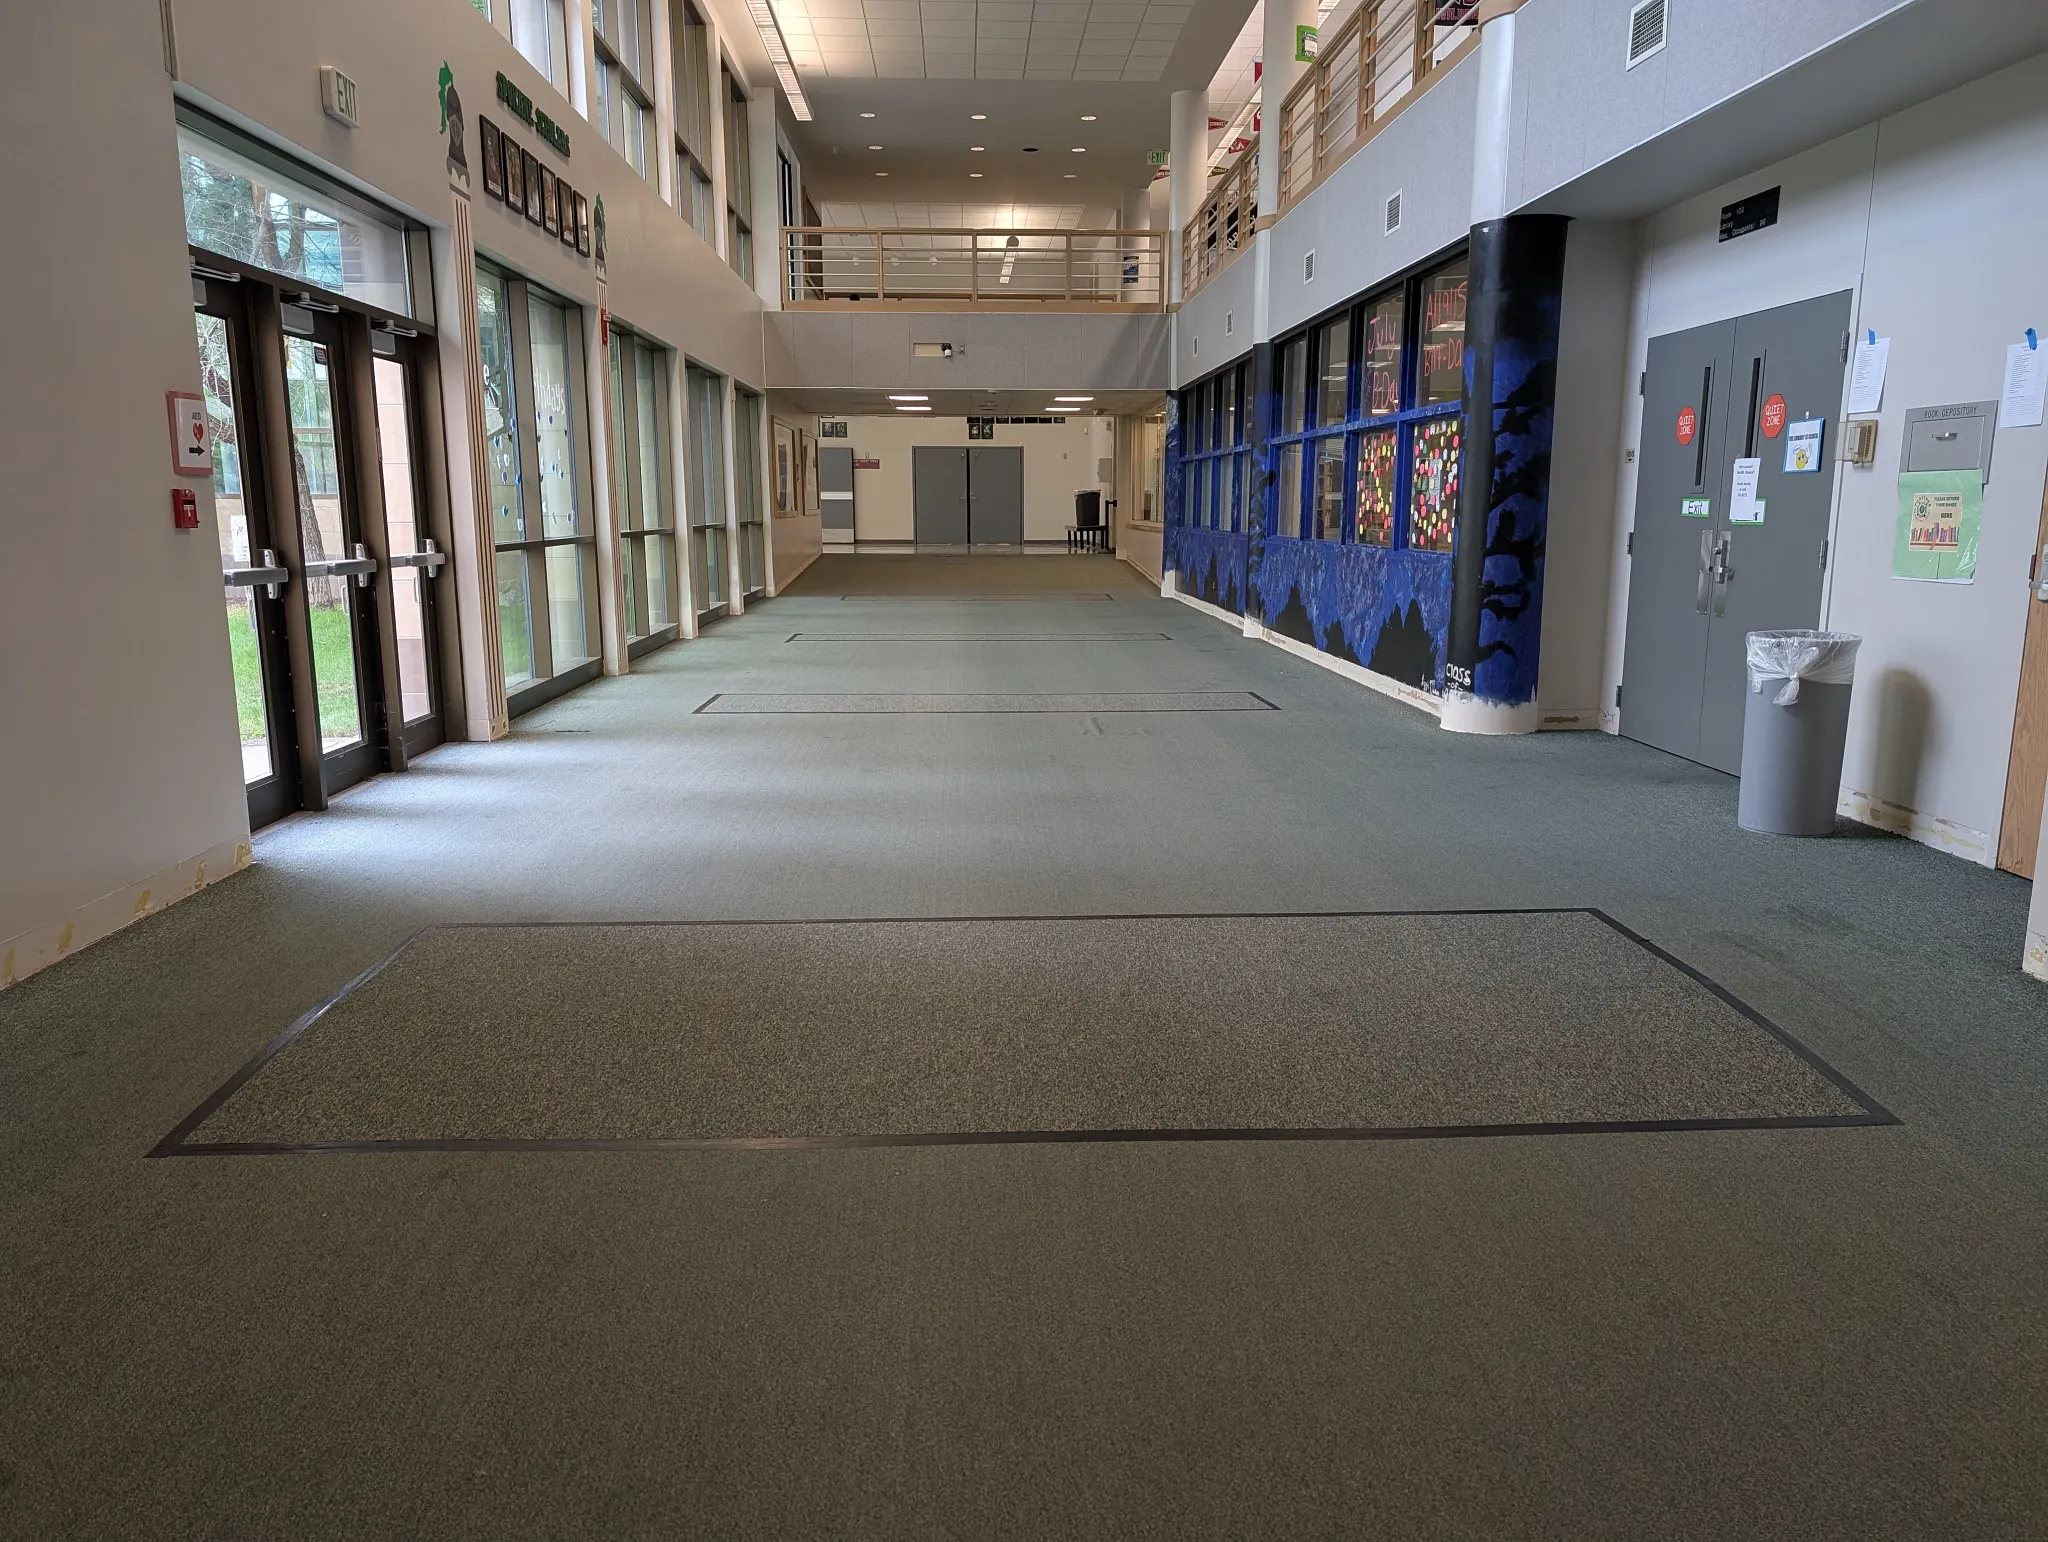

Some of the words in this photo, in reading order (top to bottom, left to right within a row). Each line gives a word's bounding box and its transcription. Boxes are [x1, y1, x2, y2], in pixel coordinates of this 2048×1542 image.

[335, 71, 358, 123] EXIT
[1151, 152, 1166, 164] EXIT
[1367, 312, 1397, 361] July
[191, 411, 202, 421] AED
[1764, 404, 1785, 416] QUIET
[1923, 410, 1939, 419] BOOK
[1941, 406, 1978, 417] DEPOSITORY
[1679, 415, 1695, 426] QUIET
[1766, 415, 1781, 427] ZONE
[1680, 425, 1692, 436] ZONE
[1687, 501, 1703, 515] Exit
